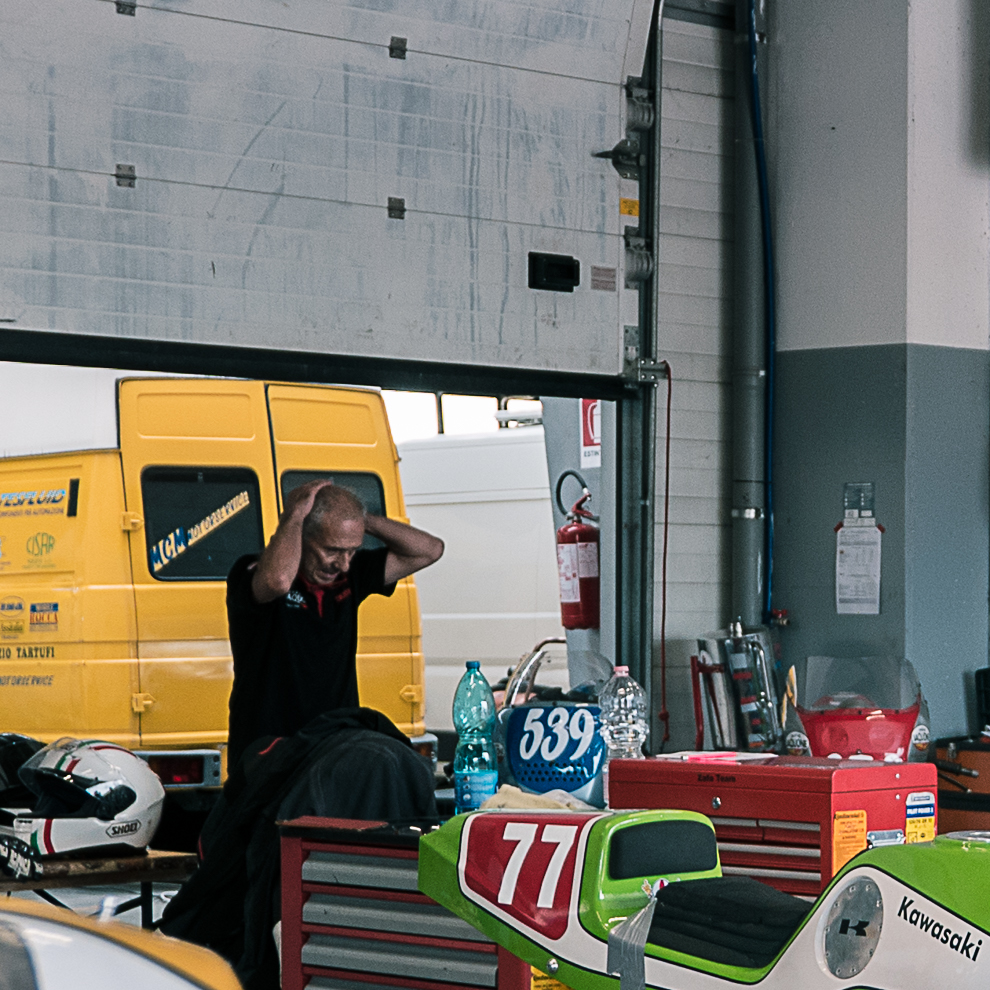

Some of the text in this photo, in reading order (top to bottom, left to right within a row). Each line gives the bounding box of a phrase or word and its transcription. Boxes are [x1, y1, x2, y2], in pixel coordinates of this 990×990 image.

[150, 526, 187, 572] MCM
[17, 646, 55, 659] TARTUFI
[519, 706, 596, 761] 539
[111, 823, 138, 836] SHOEI
[497, 821, 579, 909] 77
[897, 896, 983, 962] Kawasaki
